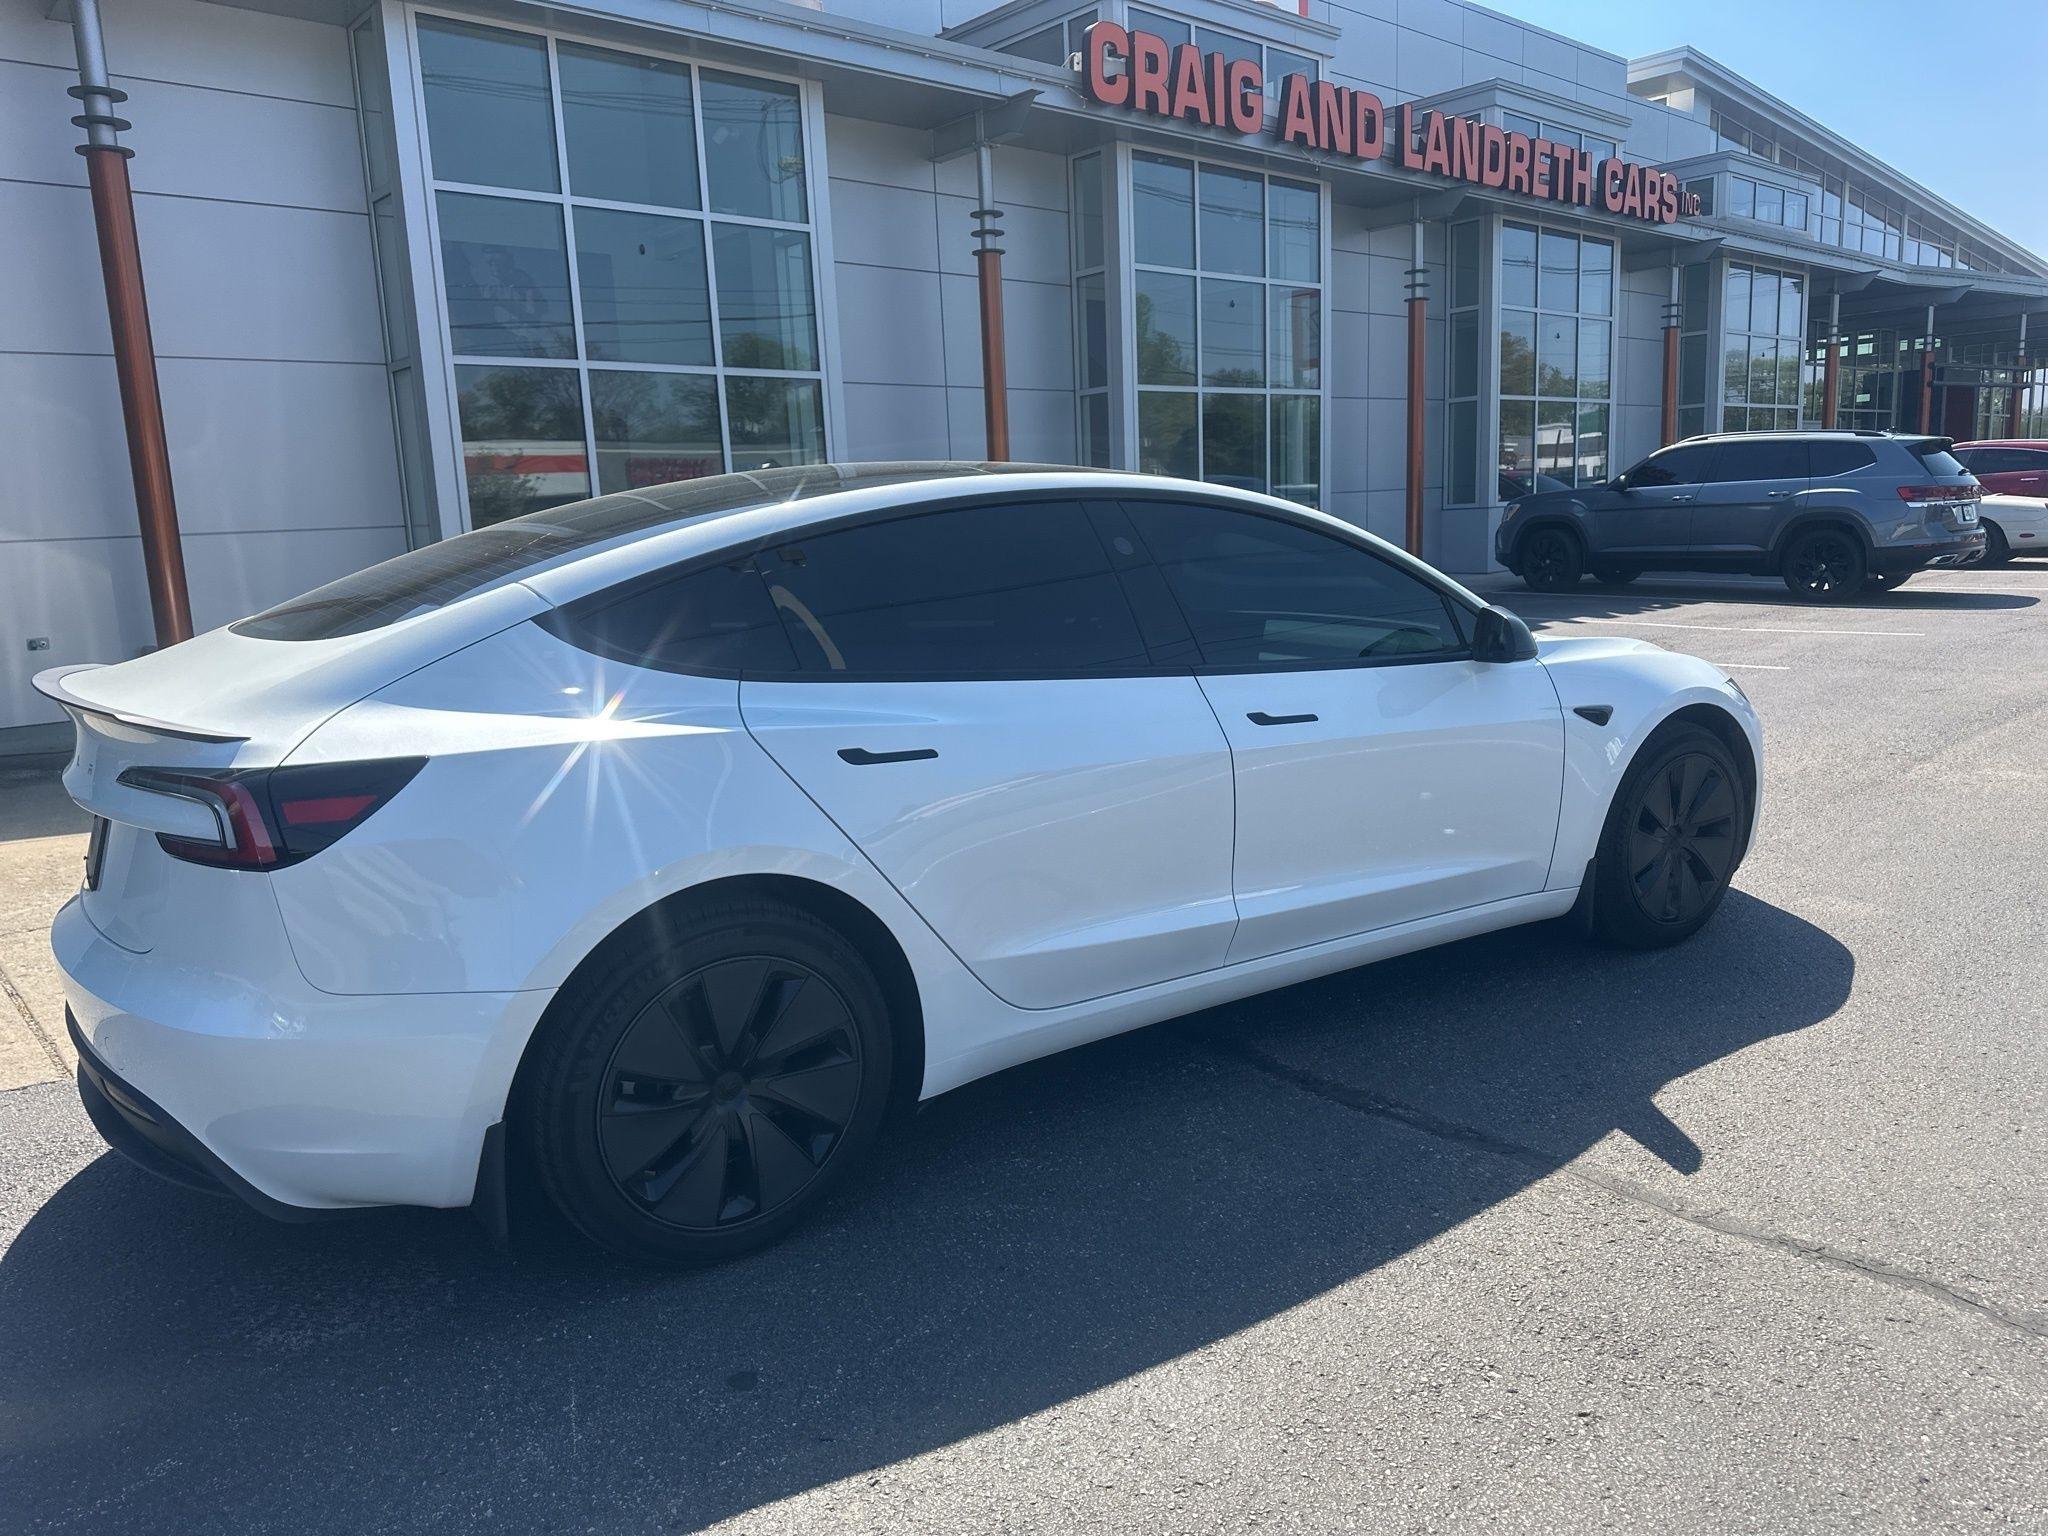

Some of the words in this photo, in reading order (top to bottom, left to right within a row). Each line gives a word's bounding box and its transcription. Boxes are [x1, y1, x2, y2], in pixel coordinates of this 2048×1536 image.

[1088, 21, 1264, 134] CRAIG
[1283, 74, 1384, 160] AND
[1402, 103, 1593, 206] LANDRETH
[1604, 157, 1678, 224] CARS
